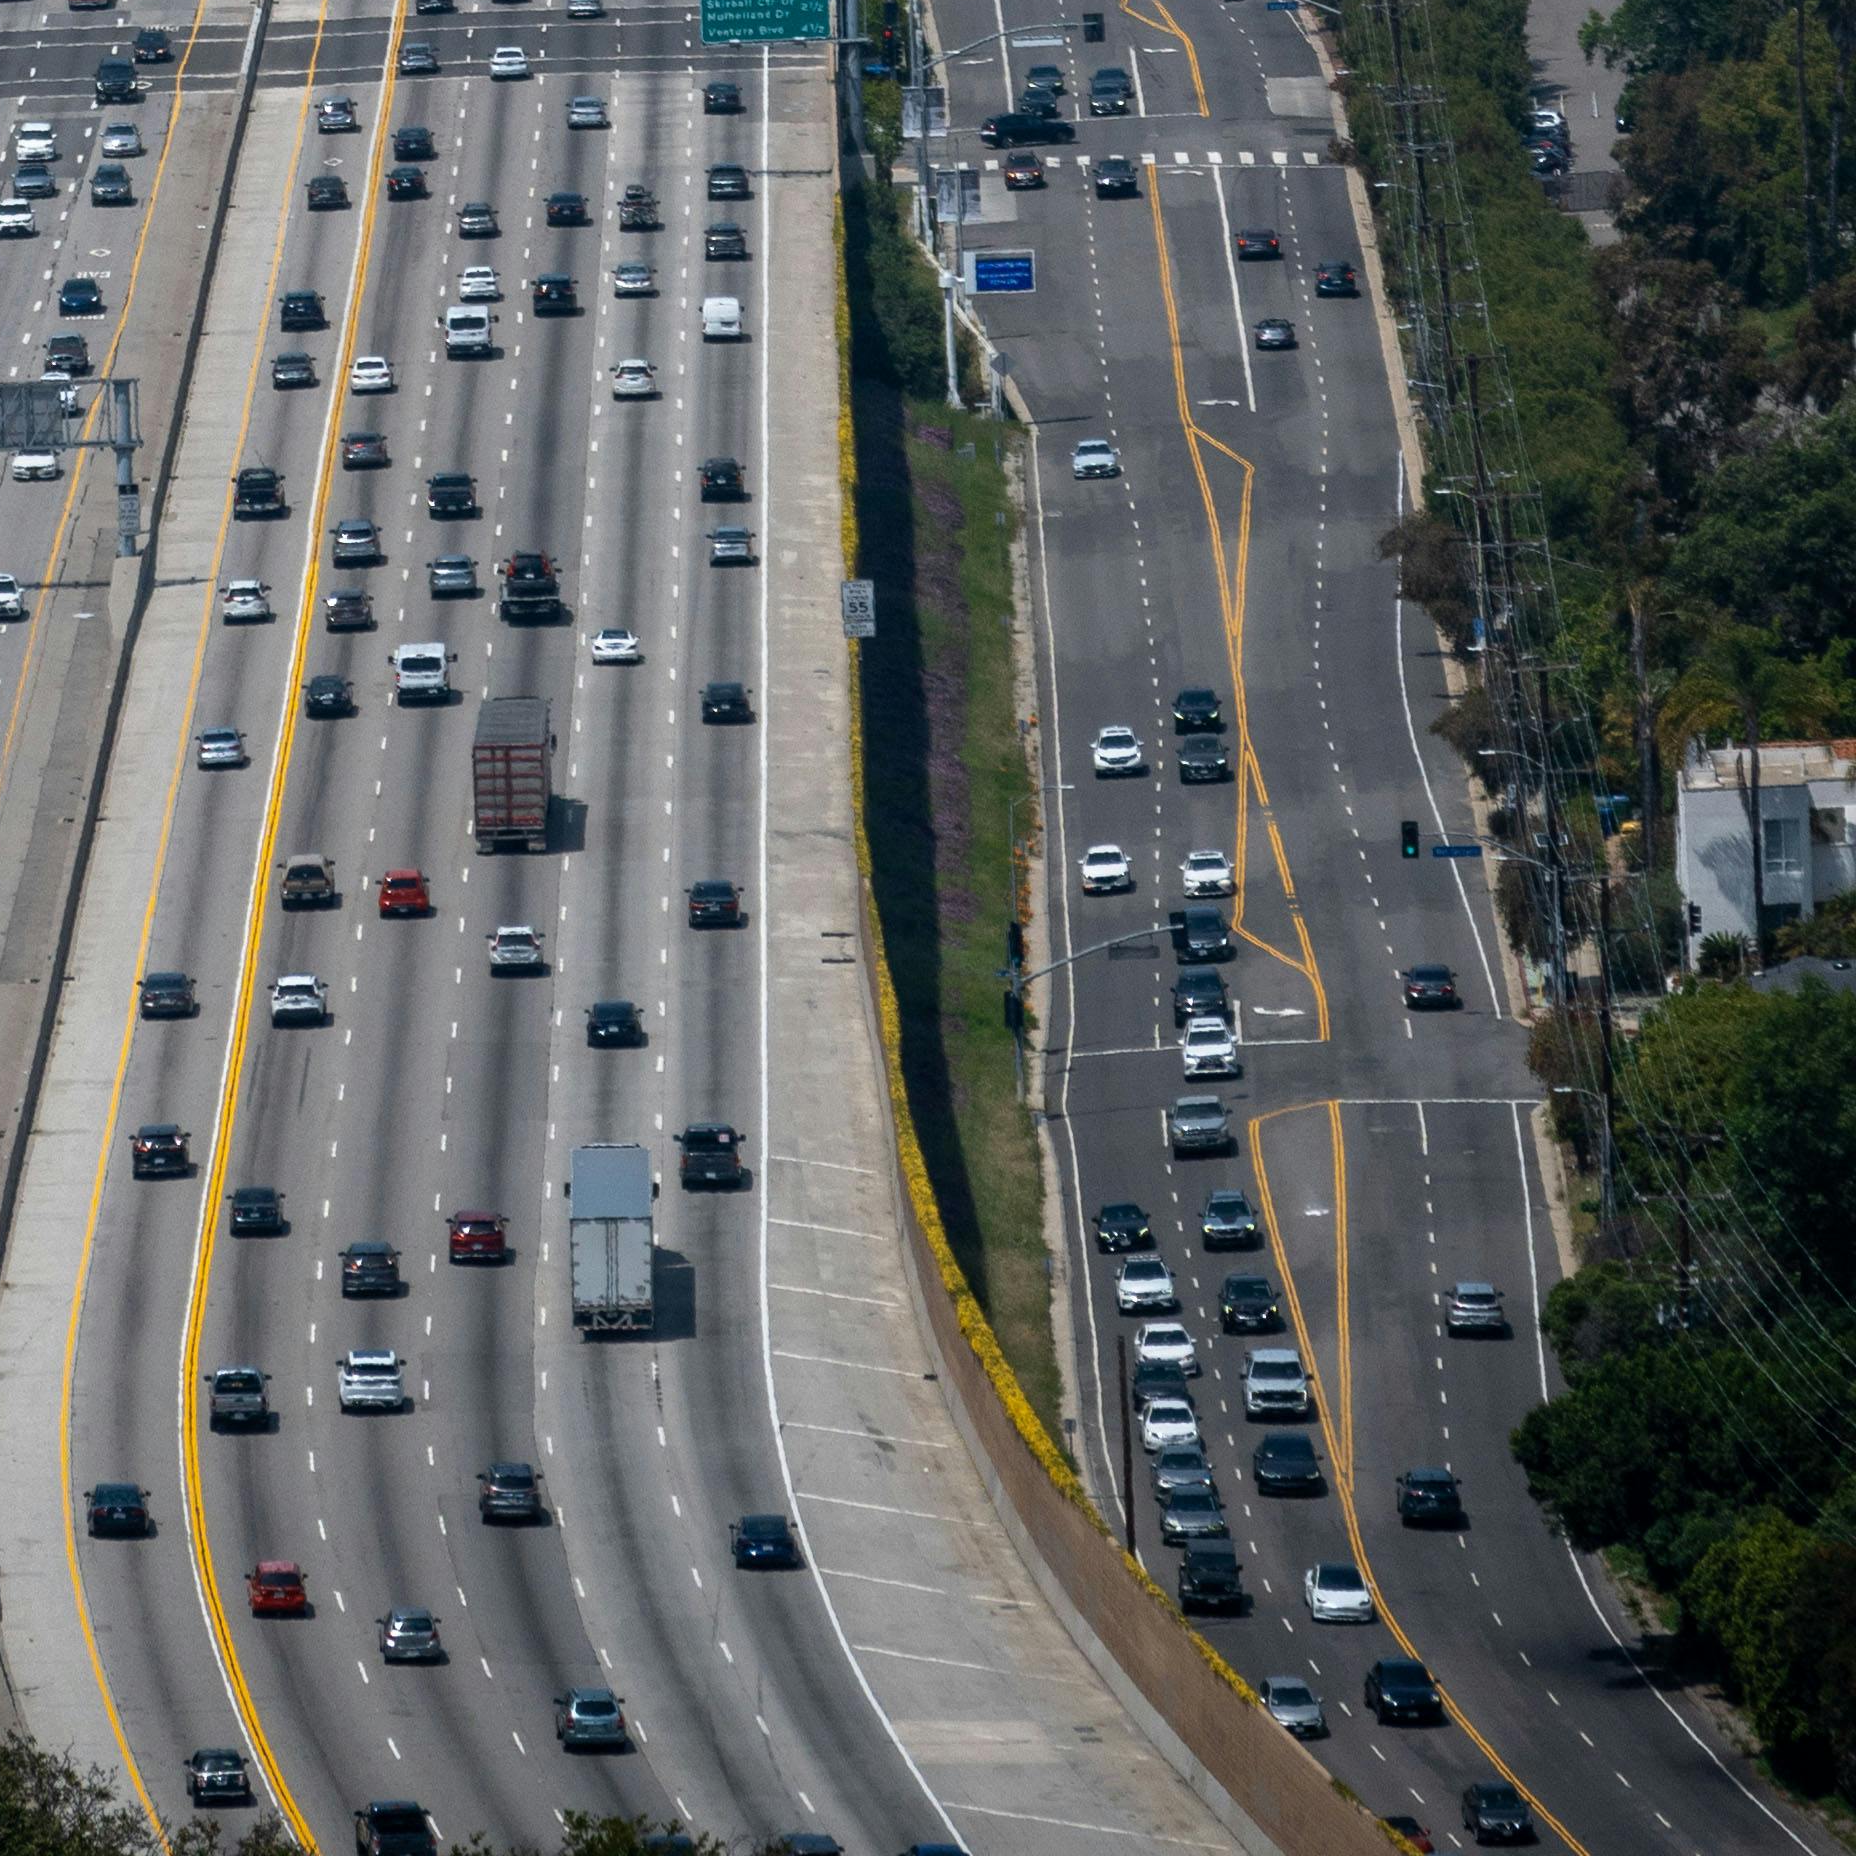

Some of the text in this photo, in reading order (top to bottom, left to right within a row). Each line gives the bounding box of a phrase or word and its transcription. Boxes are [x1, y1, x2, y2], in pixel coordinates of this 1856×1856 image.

[706, 0, 752, 9] Skirball
[707, 9, 790, 22] Mulholland Dr
[708, 25, 784, 38] Ventura Blvd
[849, 602, 868, 613] 55
